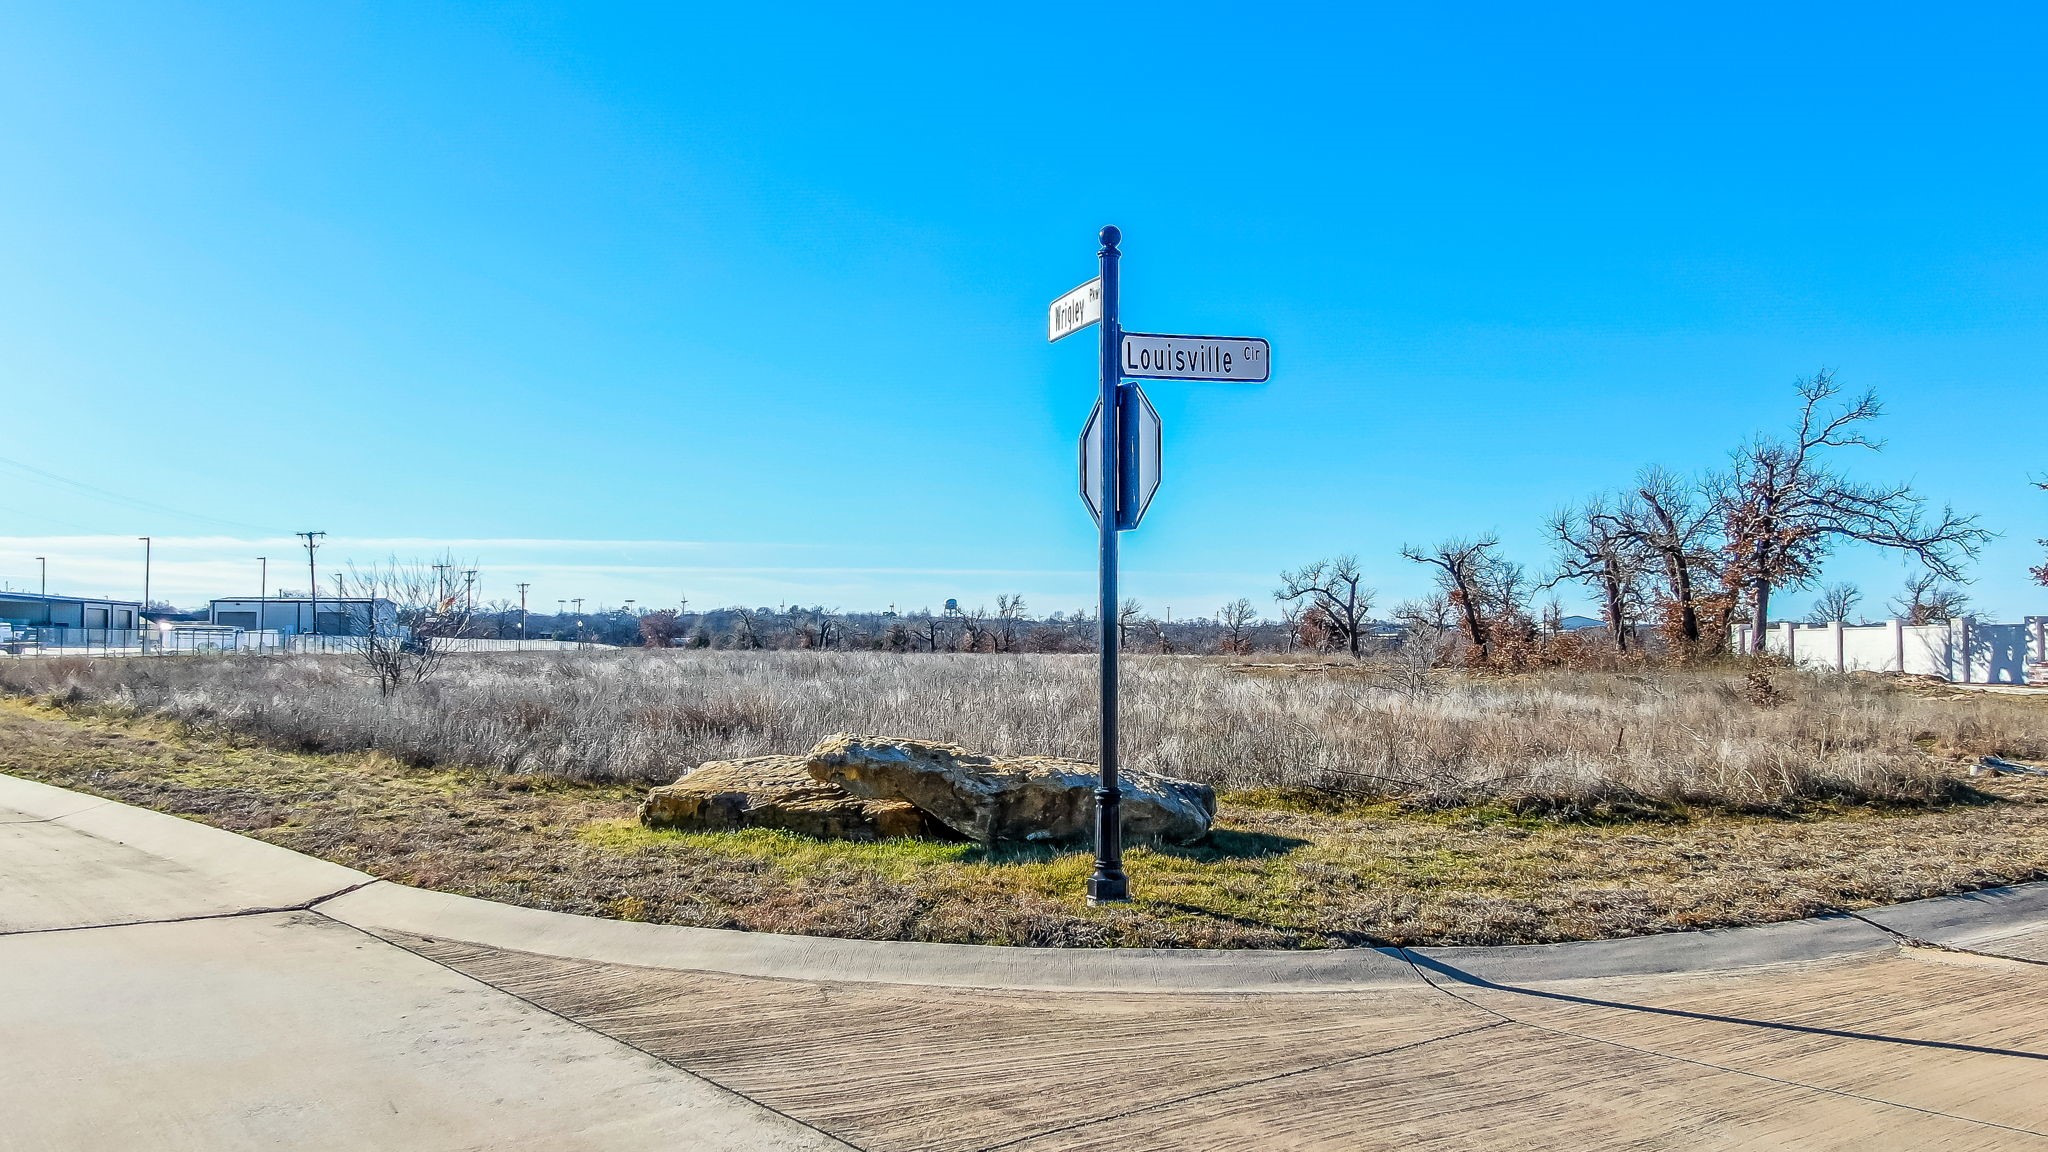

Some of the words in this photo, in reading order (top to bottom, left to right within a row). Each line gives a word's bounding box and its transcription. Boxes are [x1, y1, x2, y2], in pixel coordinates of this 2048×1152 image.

[1055, 298, 1084, 331] Wrigley
[1089, 287, 1100, 302] Pkw
[1127, 341, 1232, 373] Louisville
[1244, 346, 1260, 361] Cir
